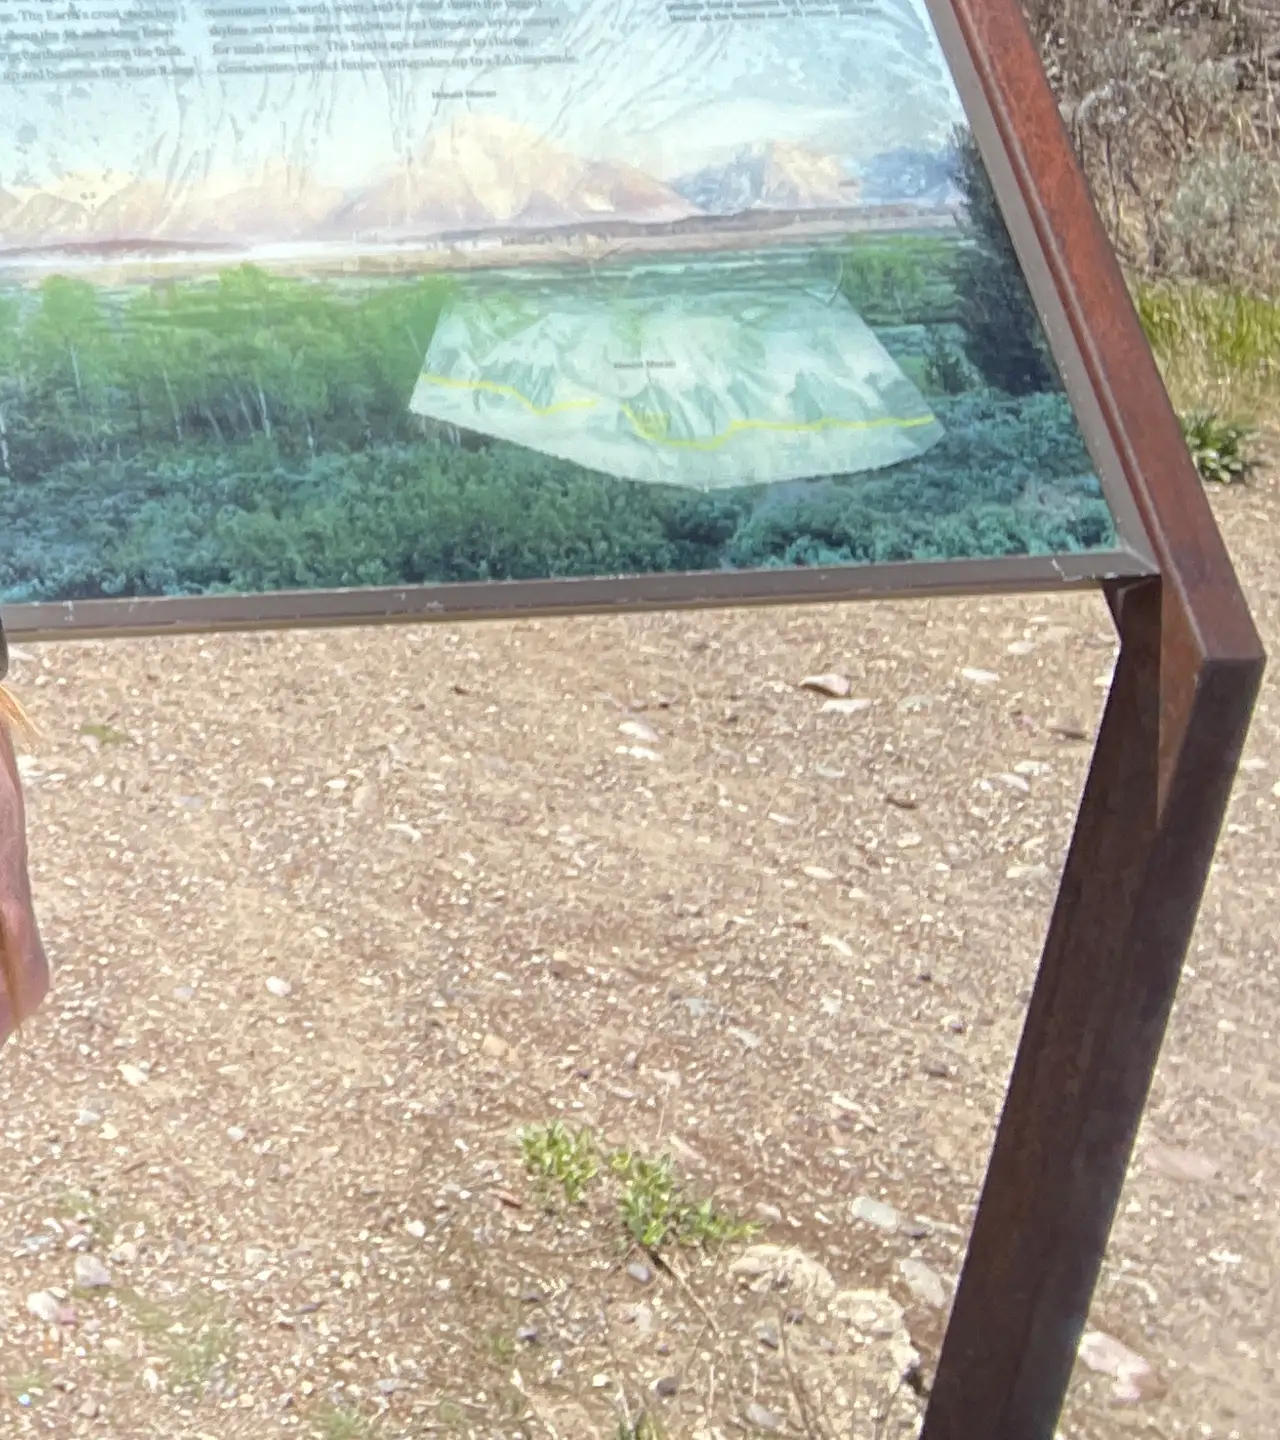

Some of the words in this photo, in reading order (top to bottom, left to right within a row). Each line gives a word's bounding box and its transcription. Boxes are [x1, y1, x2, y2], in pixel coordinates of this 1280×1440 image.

[19, 10, 43, 21] The
[134, 47, 152, 58] the
[22, 67, 43, 79] and
